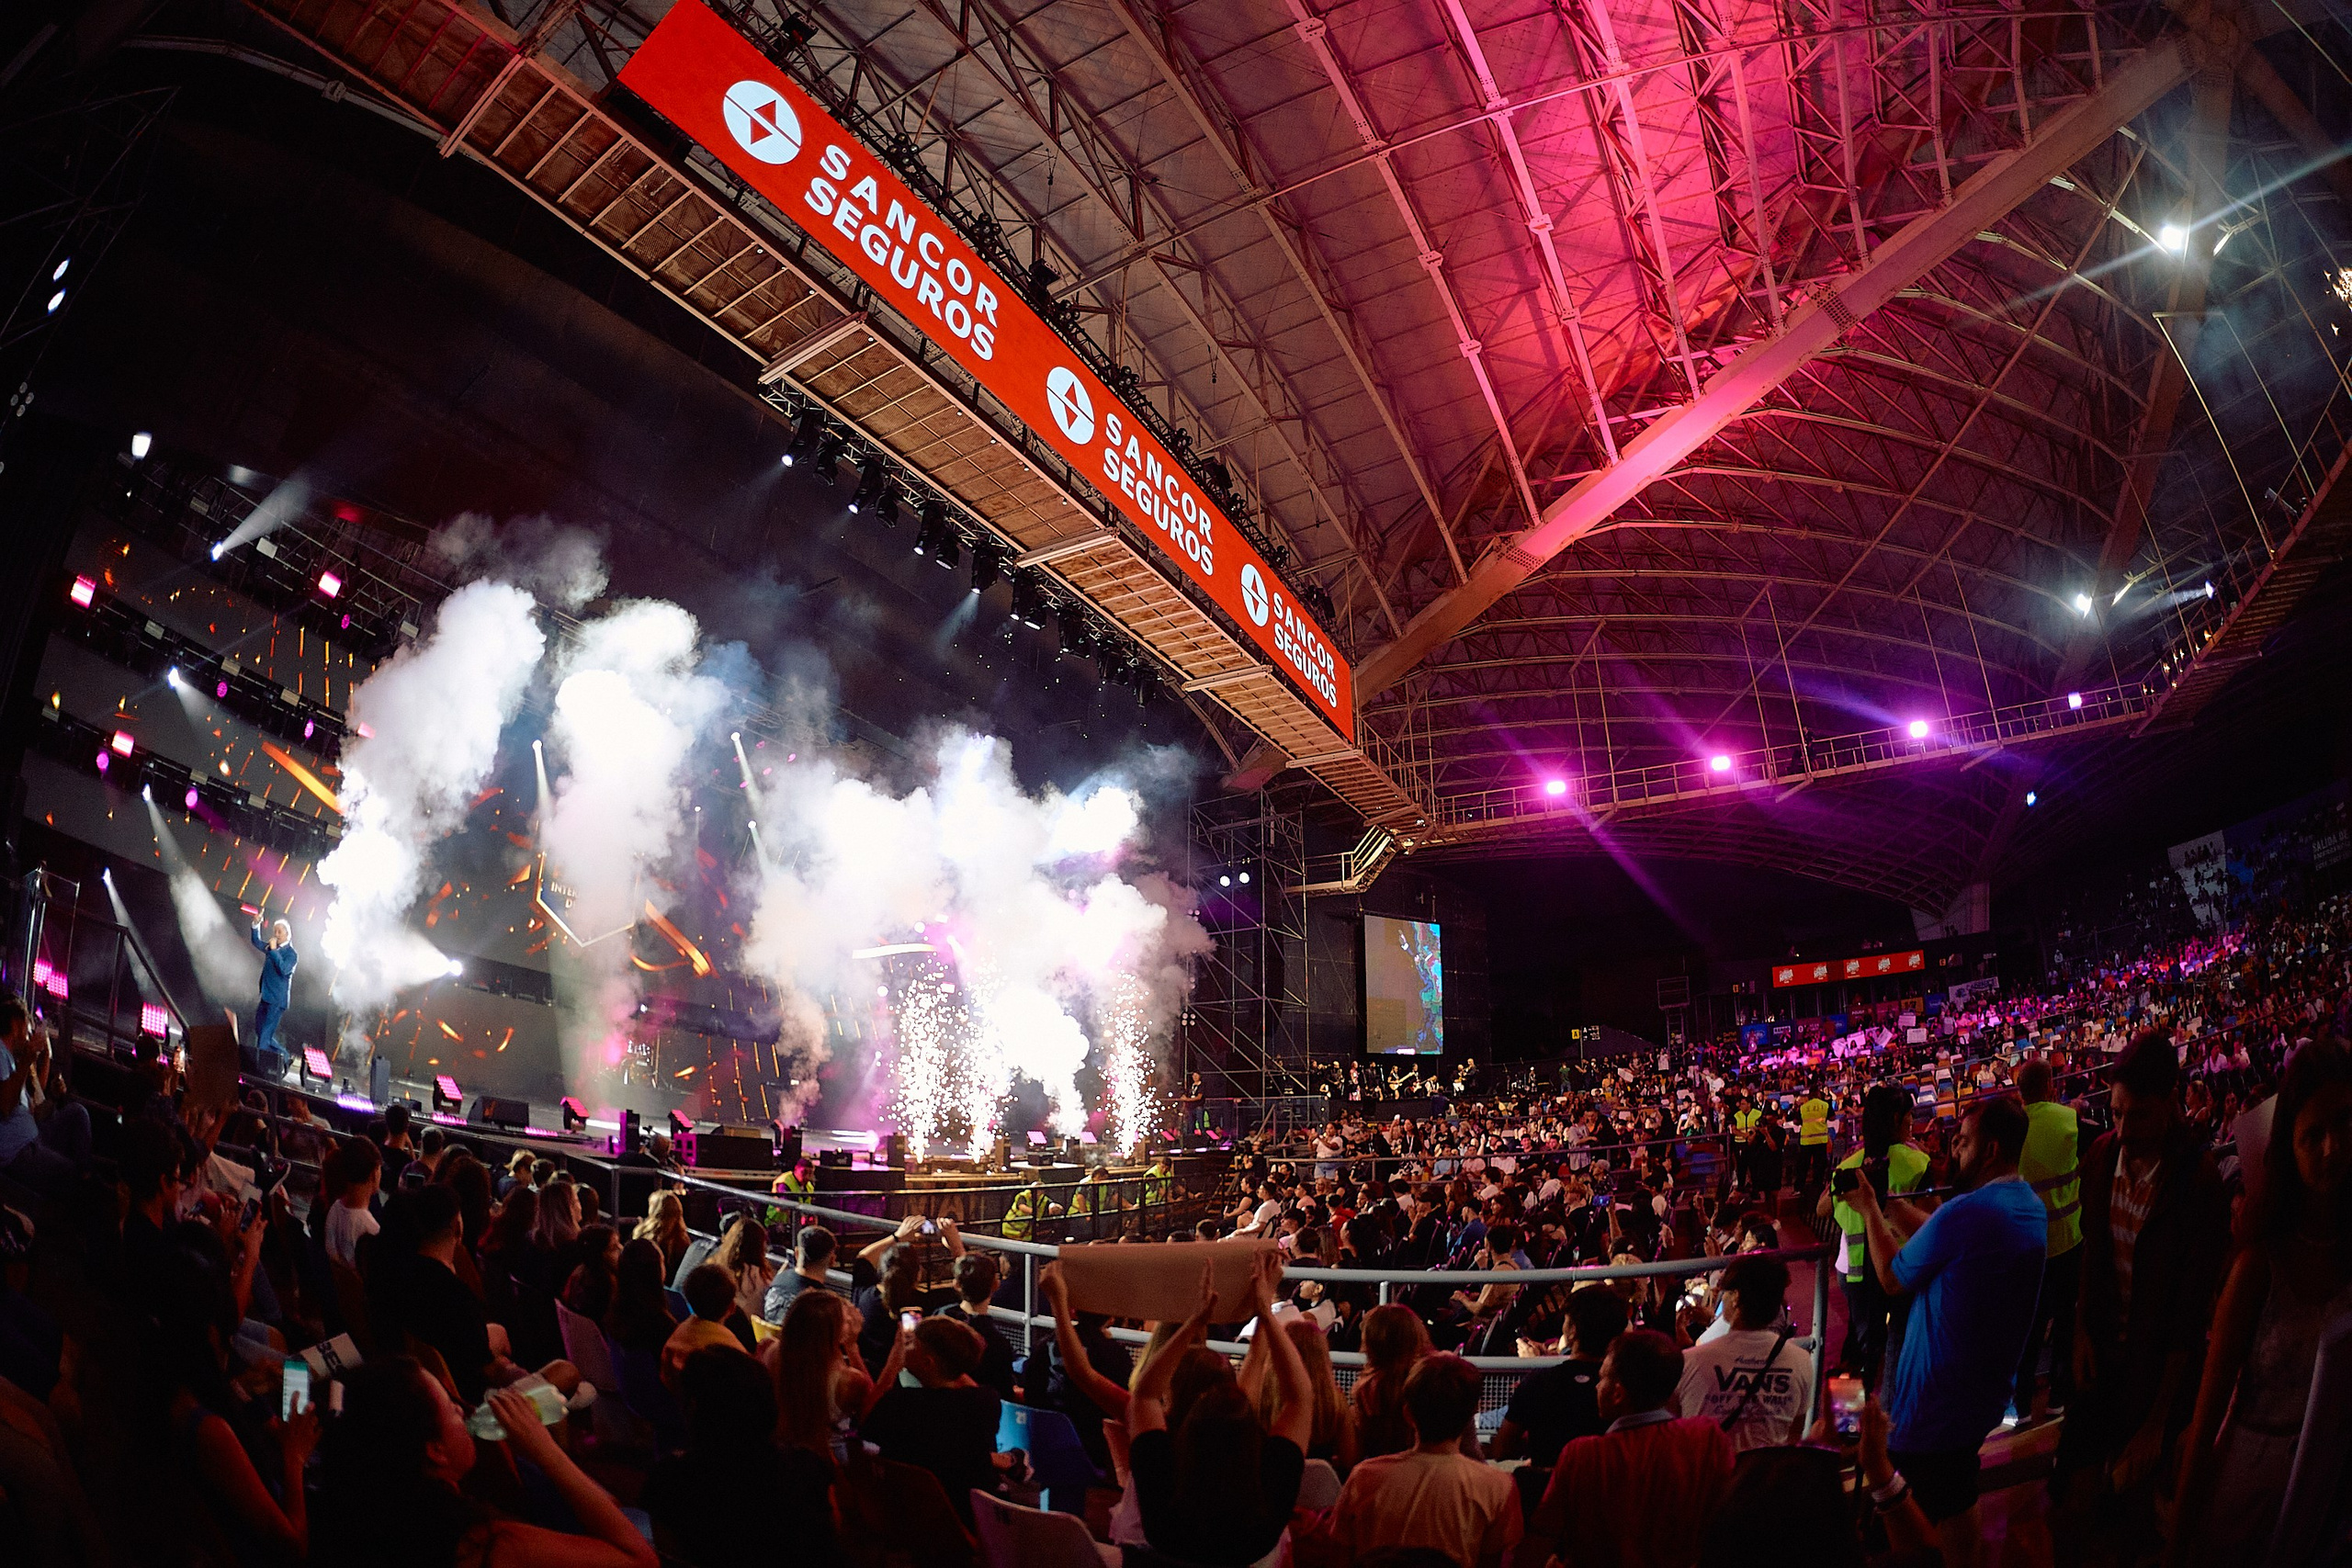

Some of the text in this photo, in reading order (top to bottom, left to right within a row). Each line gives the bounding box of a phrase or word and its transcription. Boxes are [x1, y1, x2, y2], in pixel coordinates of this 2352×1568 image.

[803, 176, 996, 362] SEGUROS
[819, 144, 1000, 329] SANCOR
[1102, 447, 1215, 577] SEGUROS
[1105, 412, 1215, 547] SANCOR
[1272, 592, 1336, 682] SANCOR
[1274, 622, 1338, 708] SEGUROS
[1714, 1365, 1793, 1393] VANS
